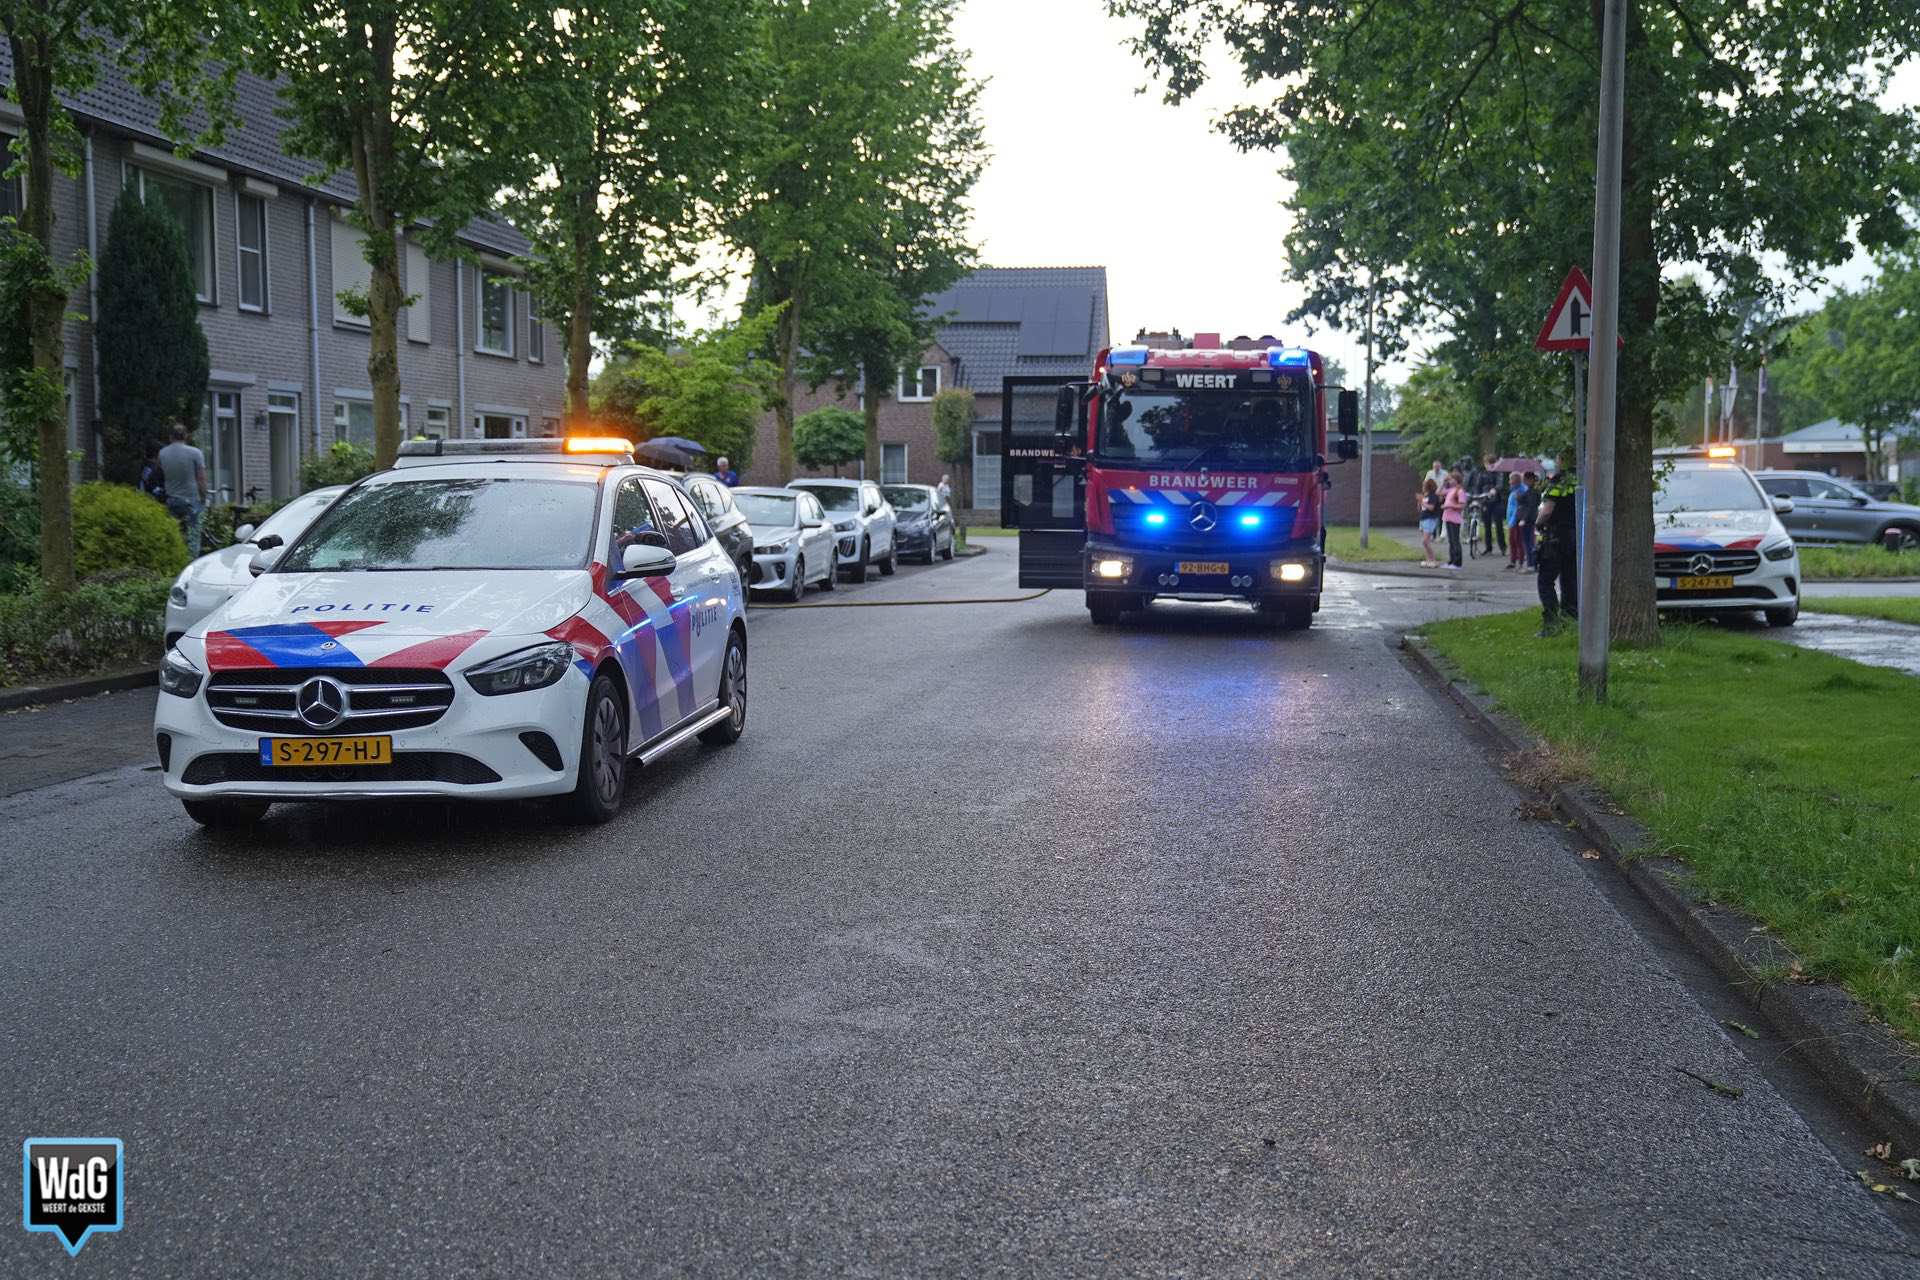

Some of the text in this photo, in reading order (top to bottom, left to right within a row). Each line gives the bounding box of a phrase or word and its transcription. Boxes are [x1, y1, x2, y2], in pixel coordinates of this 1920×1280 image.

[1176, 374, 1237, 389] WEERT
[1009, 449, 1064, 457] BRANDWE
[1149, 475, 1258, 489] BRANDWEER
[291, 603, 435, 614] POLITIE
[279, 740, 381, 761] S-297-HJ
